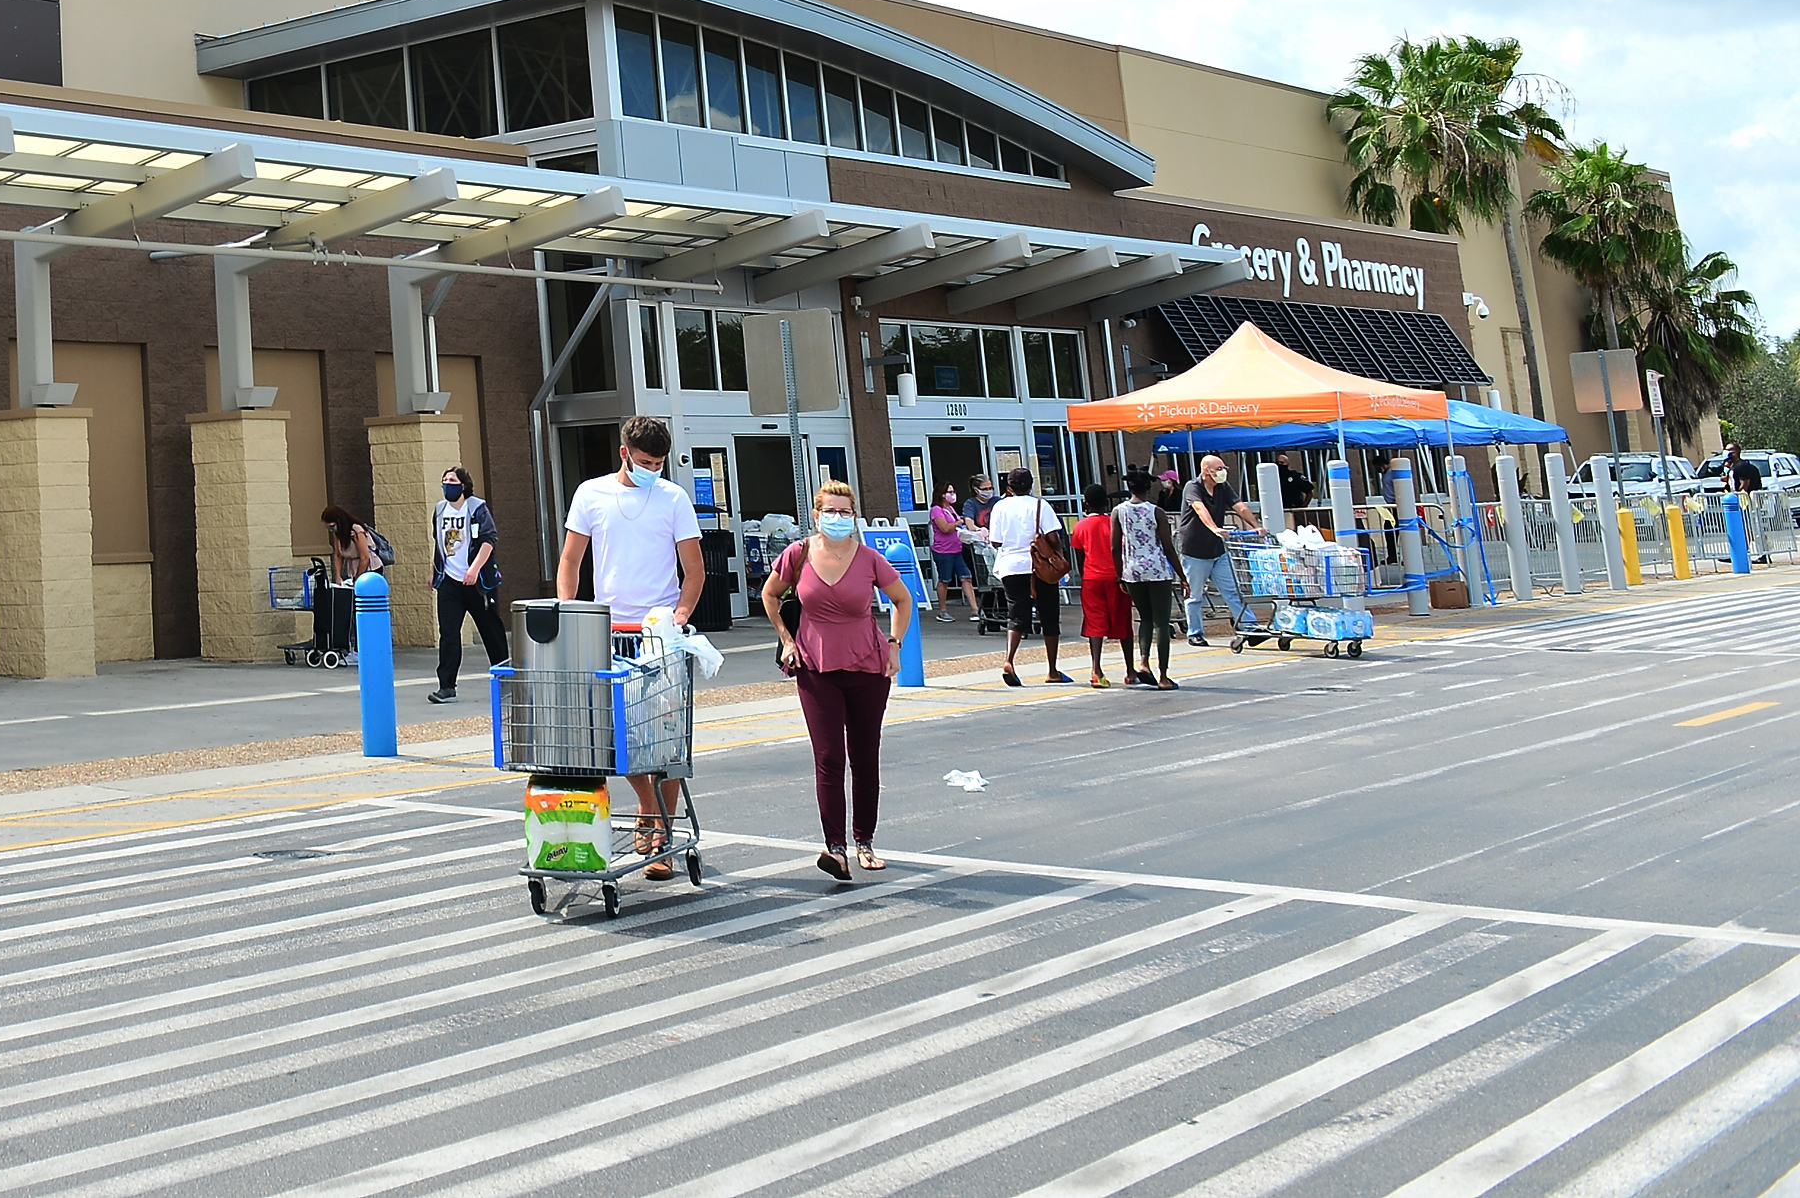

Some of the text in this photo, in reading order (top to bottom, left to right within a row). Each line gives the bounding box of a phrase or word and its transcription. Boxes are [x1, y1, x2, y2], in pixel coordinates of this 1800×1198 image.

[1296, 237, 1319, 286] &
[1320, 240, 1424, 311] Pharmacy
[442, 516, 466, 530] FIU
